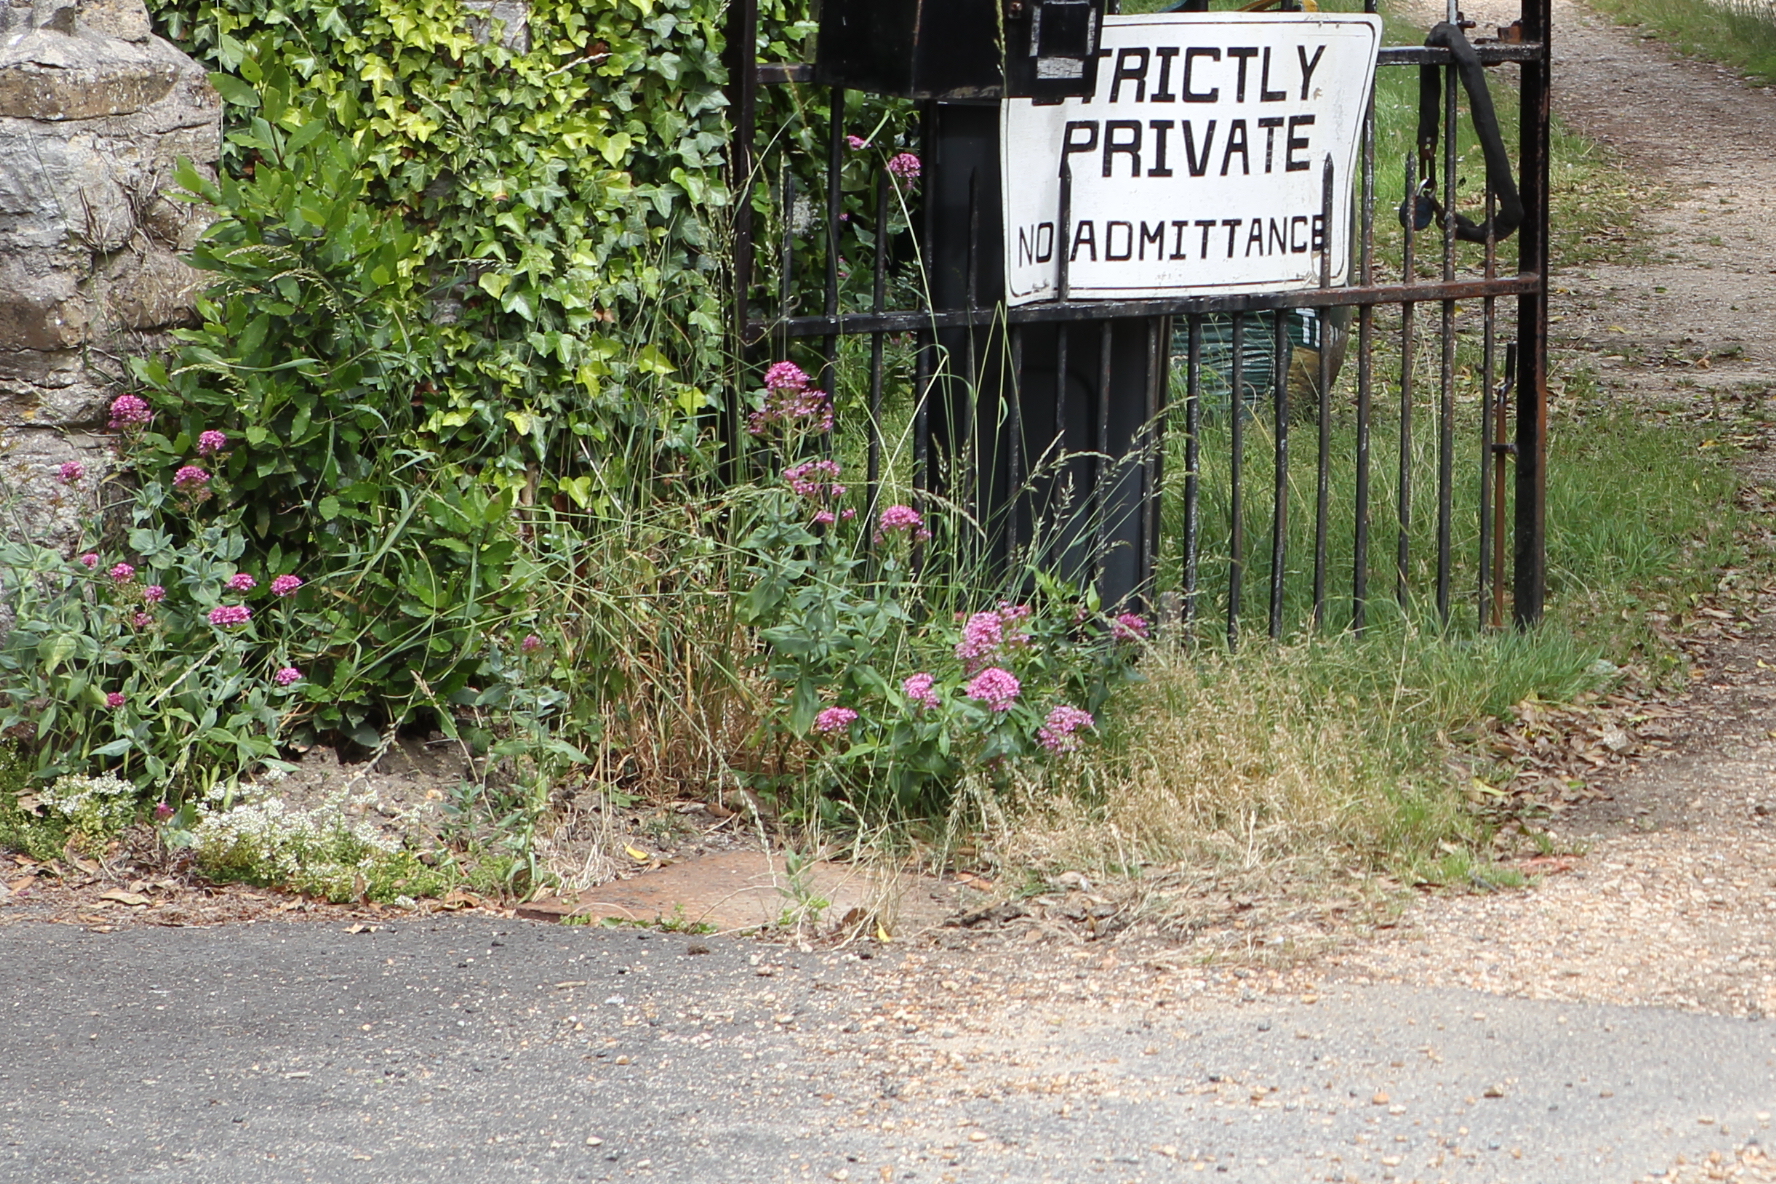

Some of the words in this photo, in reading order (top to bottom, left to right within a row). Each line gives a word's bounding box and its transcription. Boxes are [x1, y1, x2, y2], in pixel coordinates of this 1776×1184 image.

[1031, 45, 1327, 106] RICTLY
[1060, 114, 1317, 178] PRIVATE
[1018, 221, 1054, 268] NO
[1069, 214, 1326, 263] ADMITTANCE
